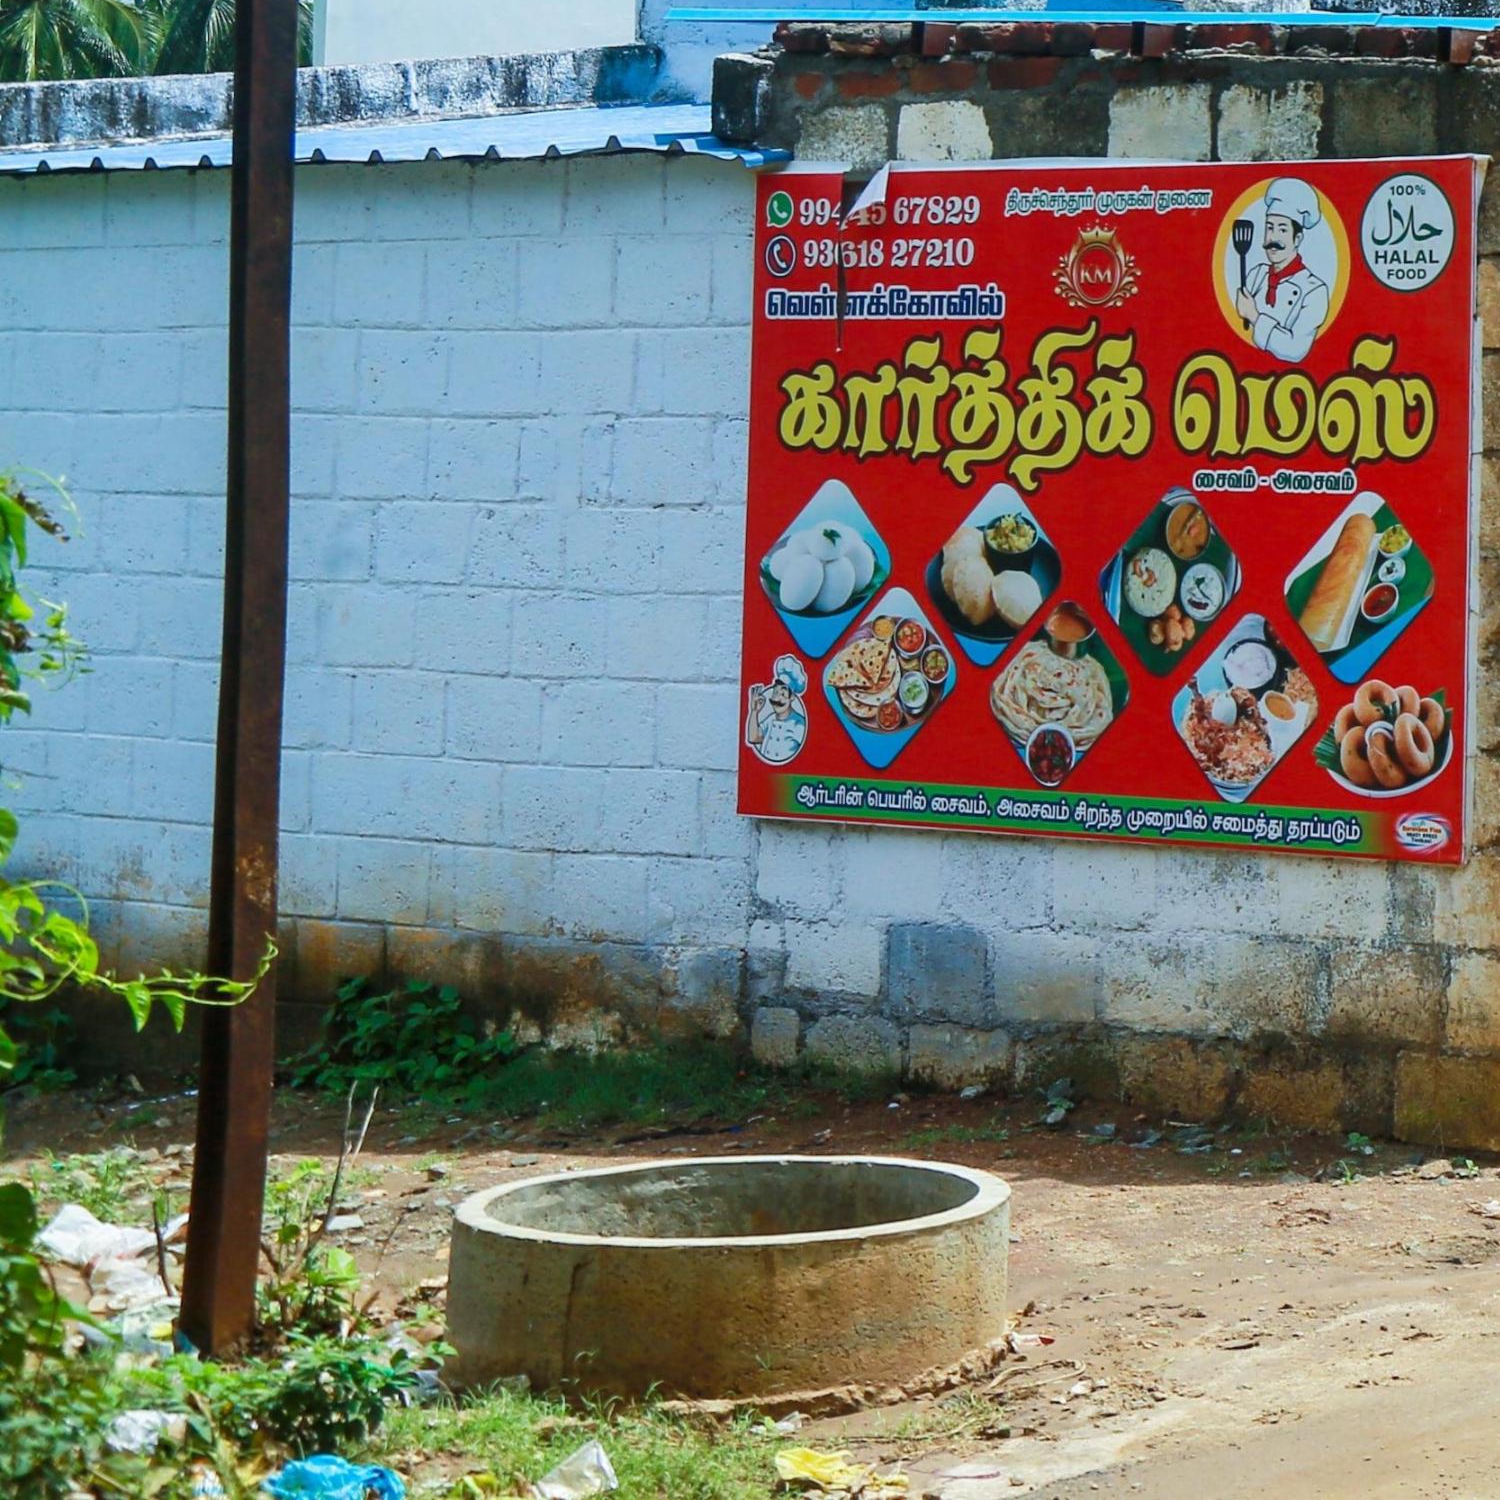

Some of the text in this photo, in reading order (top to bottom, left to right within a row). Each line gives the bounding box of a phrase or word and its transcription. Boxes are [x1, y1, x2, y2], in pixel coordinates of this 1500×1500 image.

[1006, 186, 1212, 216] திருச்செந்தூர் முருகன் துணை
[1390, 185, 1426, 196] 100%
[893, 196, 981, 225] 67829
[1371, 199, 1443, 246] حلال
[890, 238, 975, 267] 27210
[1375, 249, 1440, 264] HALAL
[1080, 265, 1112, 284] KM
[1387, 269, 1426, 280] FOOD
[780, 322, 1434, 492] கார்த்திக் மெஸ்
[1195, 469, 1256, 489] சைவம்
[1273, 471, 1355, 491] அசைவம்
[797, 784, 1362, 843] ஆர்டரின் பெயரில் சைவம், அசைவம் சிறந்த முறையில் சமைத்து தரப்படும்
